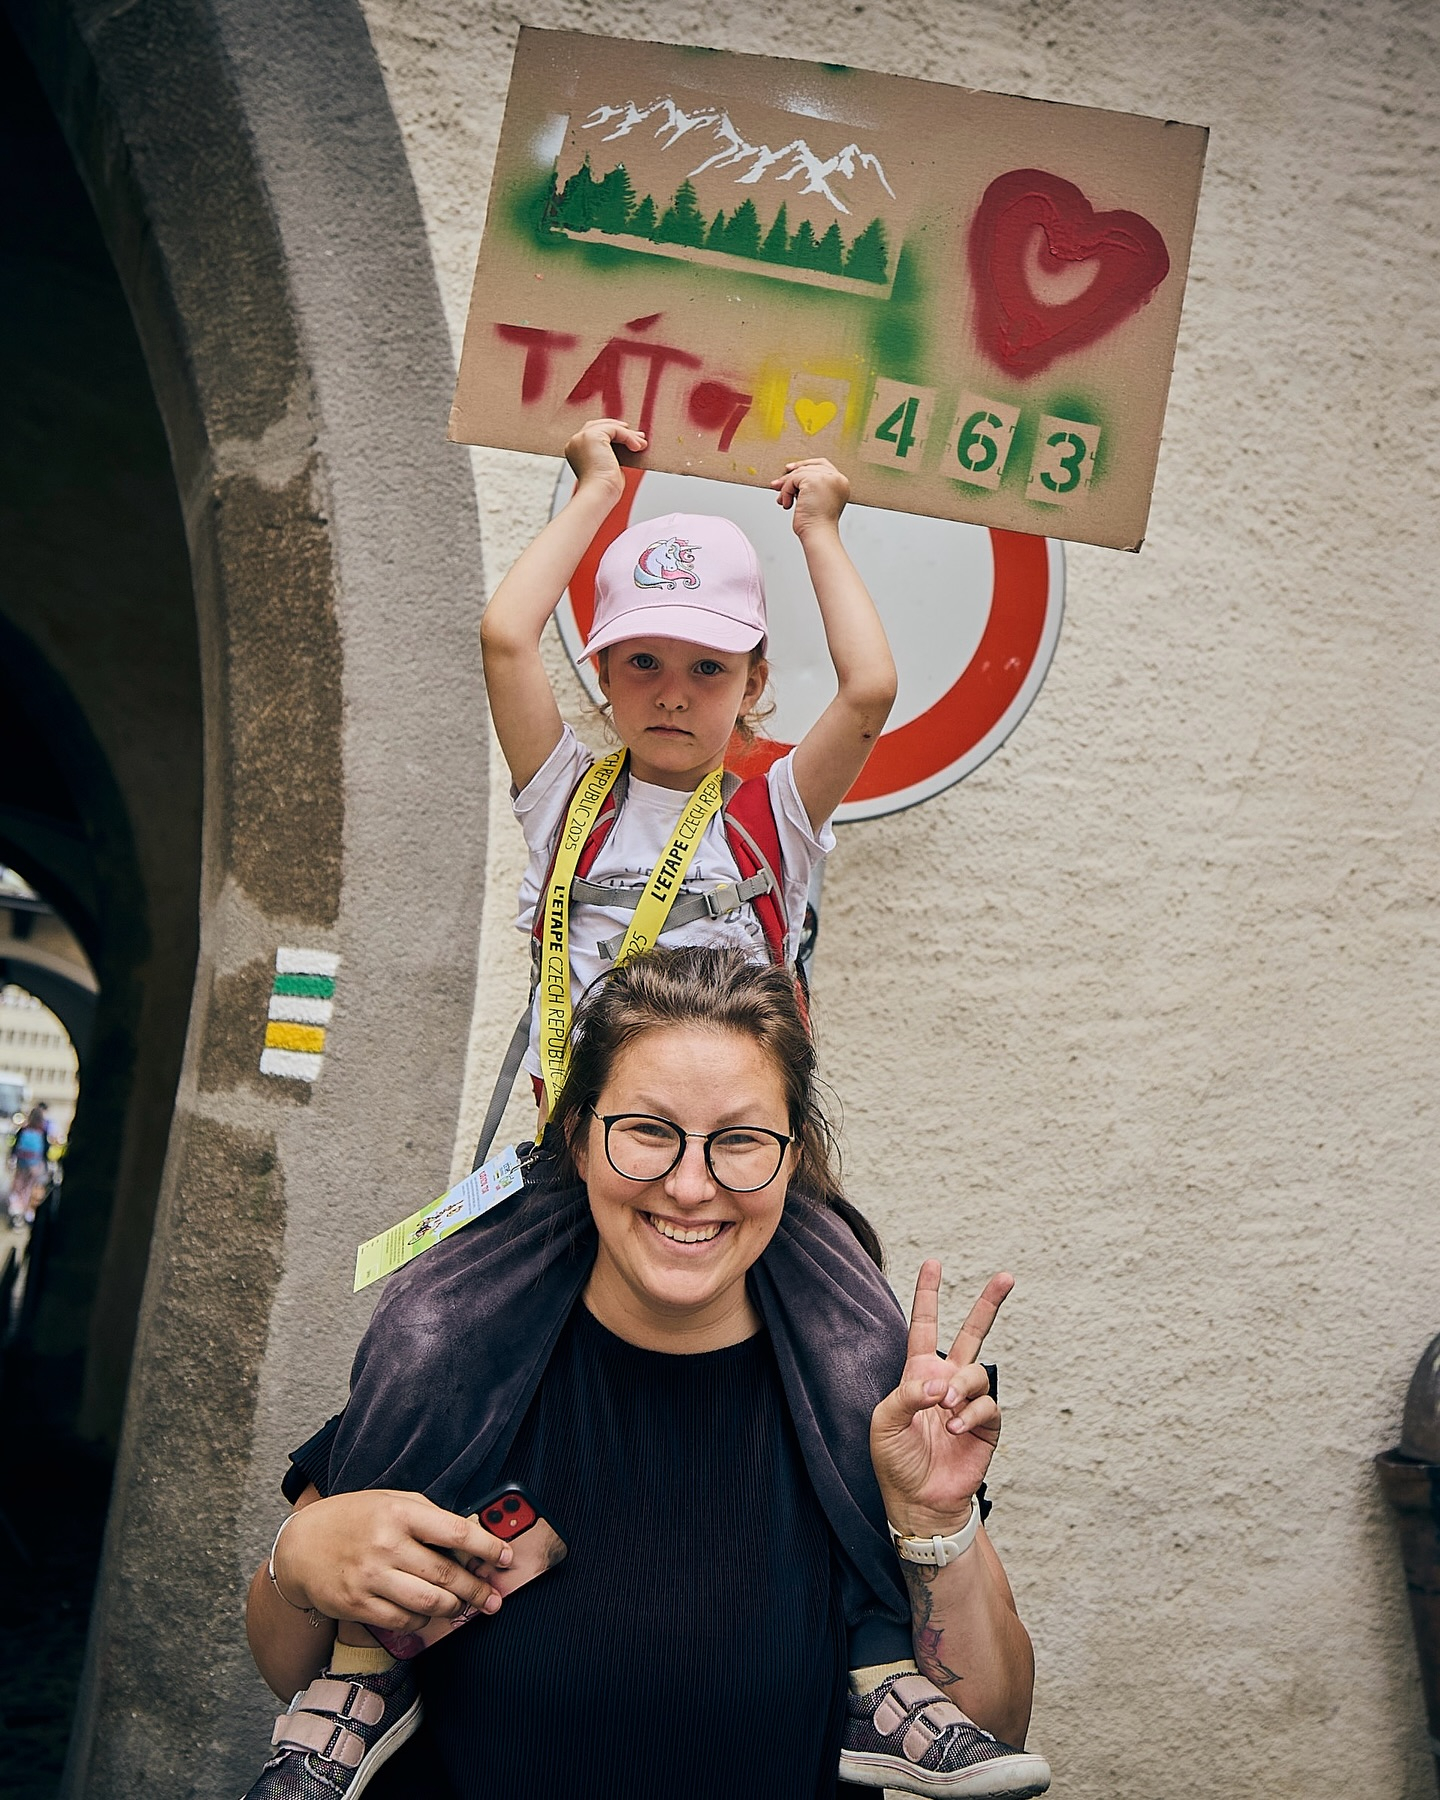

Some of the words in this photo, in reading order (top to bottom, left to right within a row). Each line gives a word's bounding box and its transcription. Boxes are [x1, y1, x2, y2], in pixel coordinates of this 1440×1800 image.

[575, 766, 615, 819] REPUBLIC
[565, 817, 587, 851] 2025
[650, 839, 689, 903] L'ETAPE
[678, 803, 709, 840] CZECH
[549, 885, 565, 953] L'ETAPE
[547, 956, 565, 1004] CZECH
[547, 1008, 567, 1078] REPUBLIC
[552, 1081, 564, 1101] 20
